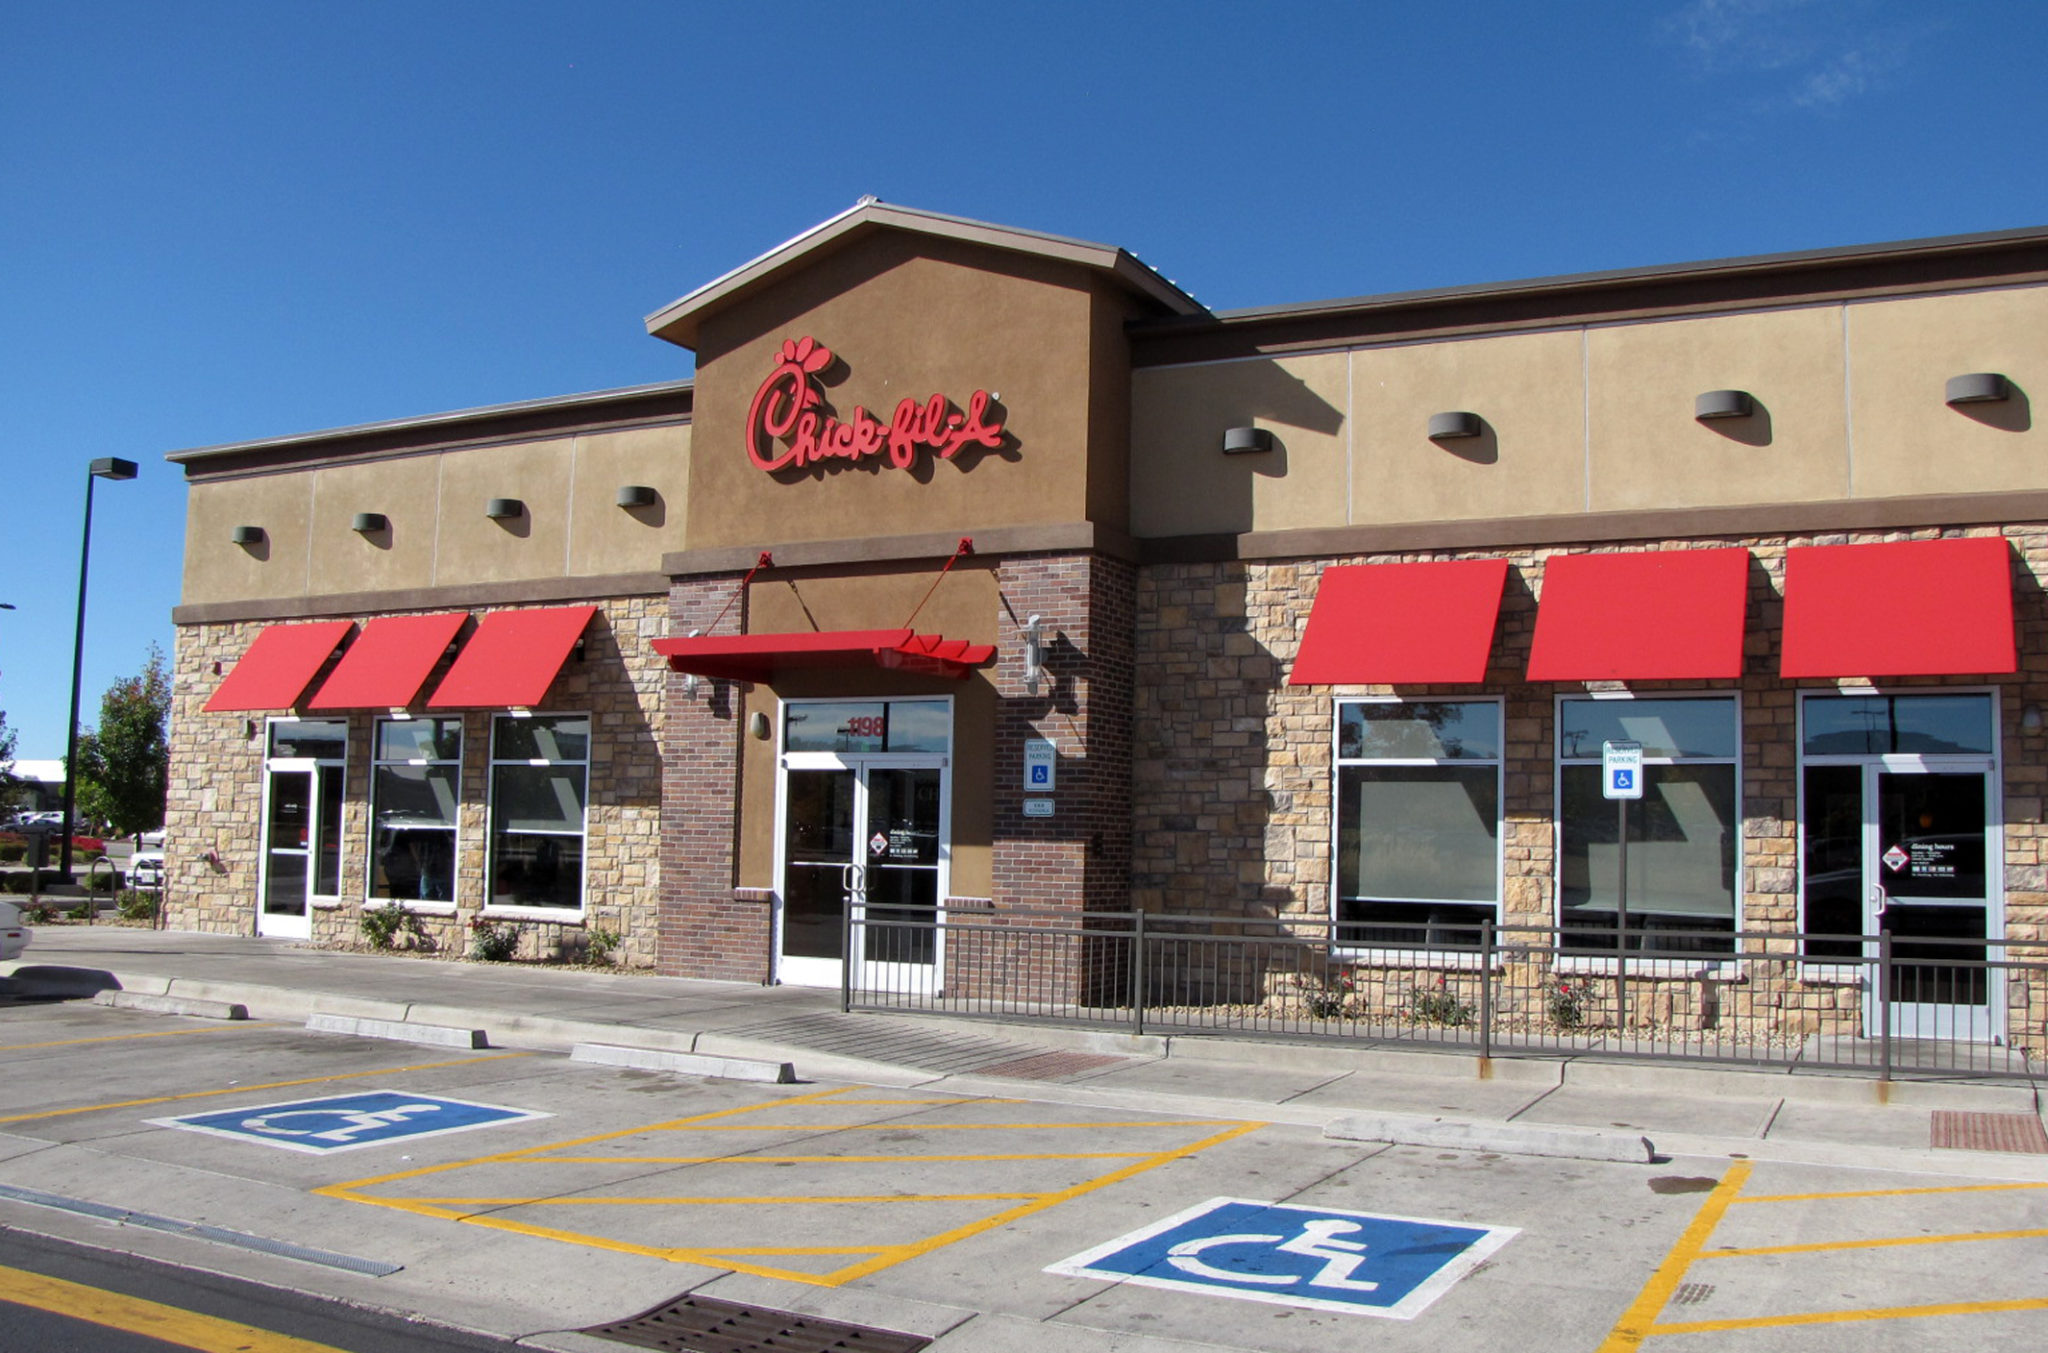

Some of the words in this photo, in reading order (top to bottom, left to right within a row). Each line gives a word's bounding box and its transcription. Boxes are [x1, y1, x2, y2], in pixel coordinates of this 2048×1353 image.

[747, 337, 1002, 471] Chick-fil-A
[848, 716, 885, 737] 1198
[1608, 755, 1638, 764] PARKING
